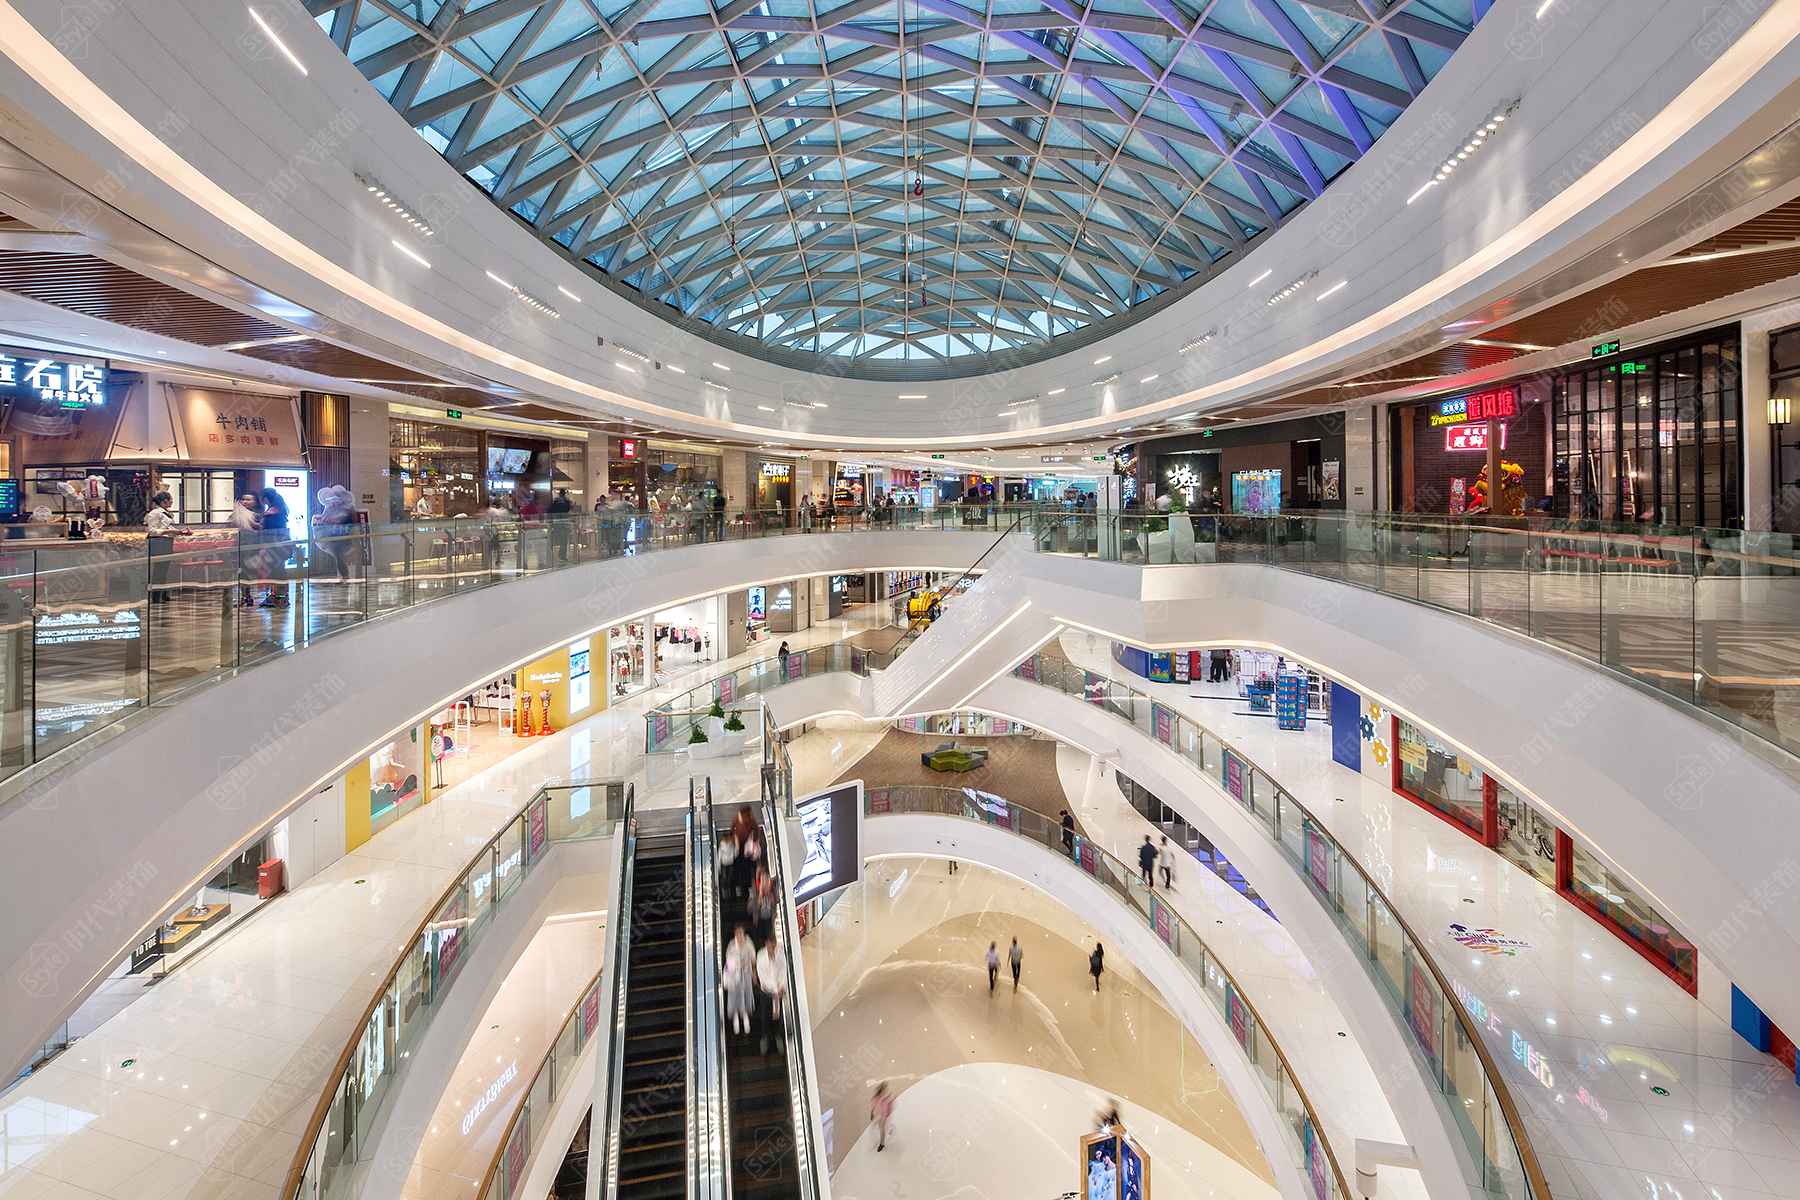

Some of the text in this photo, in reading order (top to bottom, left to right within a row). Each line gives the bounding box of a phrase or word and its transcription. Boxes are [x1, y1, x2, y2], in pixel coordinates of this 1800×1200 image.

[1468, 391, 1514, 420] 避风塘
[215, 413, 267, 432] 牛肉铺
[135, 936, 157, 957] TO TOE
